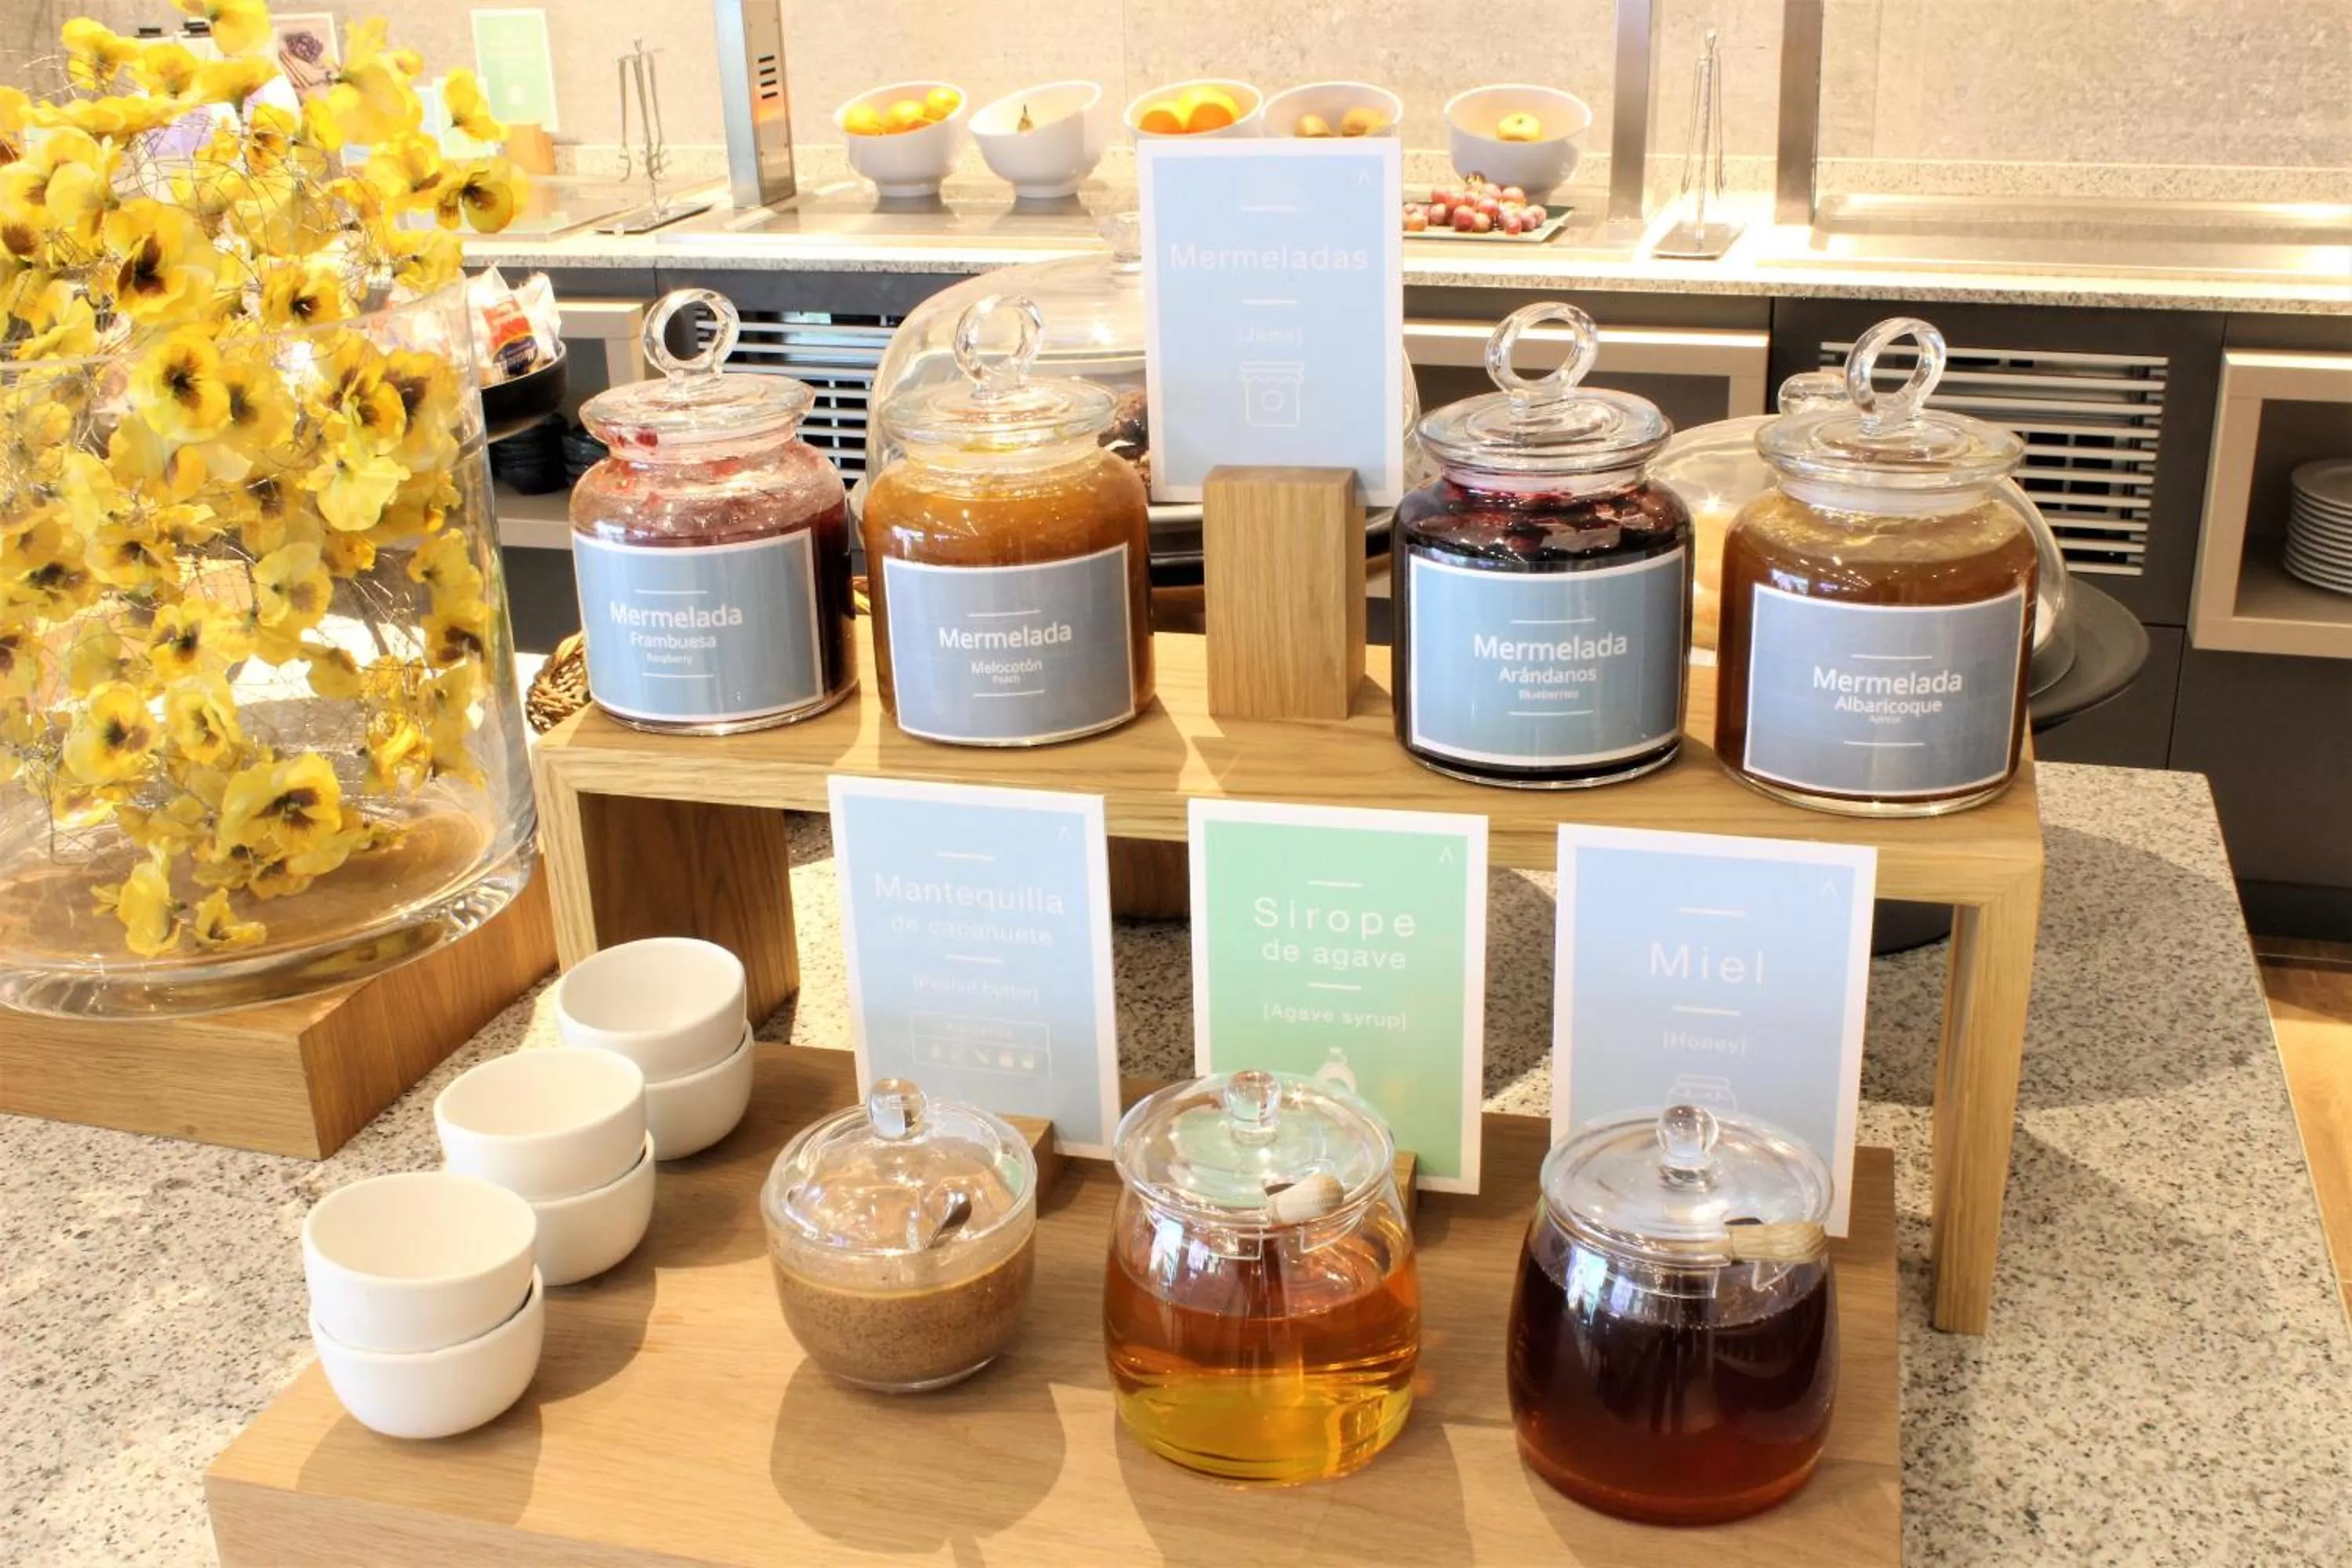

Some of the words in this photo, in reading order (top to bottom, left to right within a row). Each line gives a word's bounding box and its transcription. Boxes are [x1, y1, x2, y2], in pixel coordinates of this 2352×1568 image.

[1170, 243, 1369, 271] Mermeladas
[608, 601, 743, 628] Mermelada
[630, 632, 717, 650] Frambuesa
[938, 621, 1073, 650] Mermelada
[1473, 632, 1628, 662] Mermelada
[971, 659, 1043, 675] Melocotón
[1498, 665, 1597, 684] Arándanos
[1813, 665, 1963, 695] Mermelada
[1835, 695, 1944, 718] Albaricoque
[874, 871, 1065, 916] Mantequilla
[1253, 896, 1417, 941] Sirope
[1261, 938, 1301, 963] de
[1312, 946, 1406, 971] agave
[1650, 940, 1765, 985] Miel
